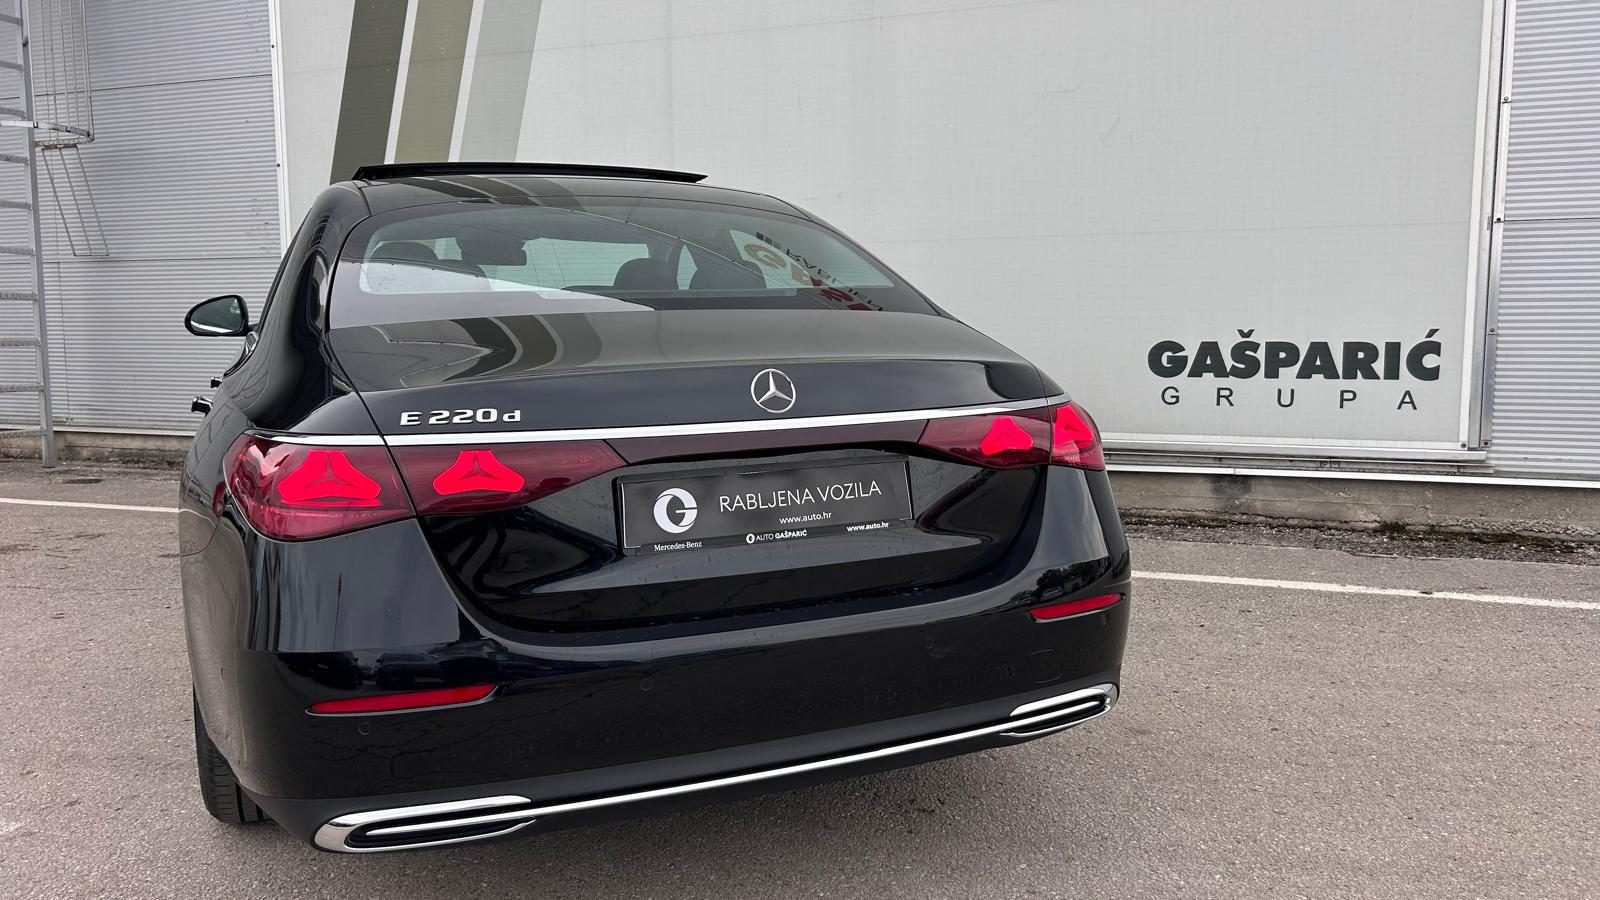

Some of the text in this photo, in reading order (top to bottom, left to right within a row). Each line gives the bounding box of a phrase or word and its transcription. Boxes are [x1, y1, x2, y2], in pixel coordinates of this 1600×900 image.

[1147, 328, 1442, 382] GAŠPARIĆ
[1161, 386, 1418, 411] GRUPA
[399, 411, 423, 426] E
[719, 480, 882, 513] RABLJENA VOZILA
[779, 511, 832, 525] www.auto.hr
[846, 521, 890, 532] www.auto.hr
[756, 529, 808, 542] AUTO GAŠPARIĆ
[653, 540, 703, 552] Mercedes-Benz
